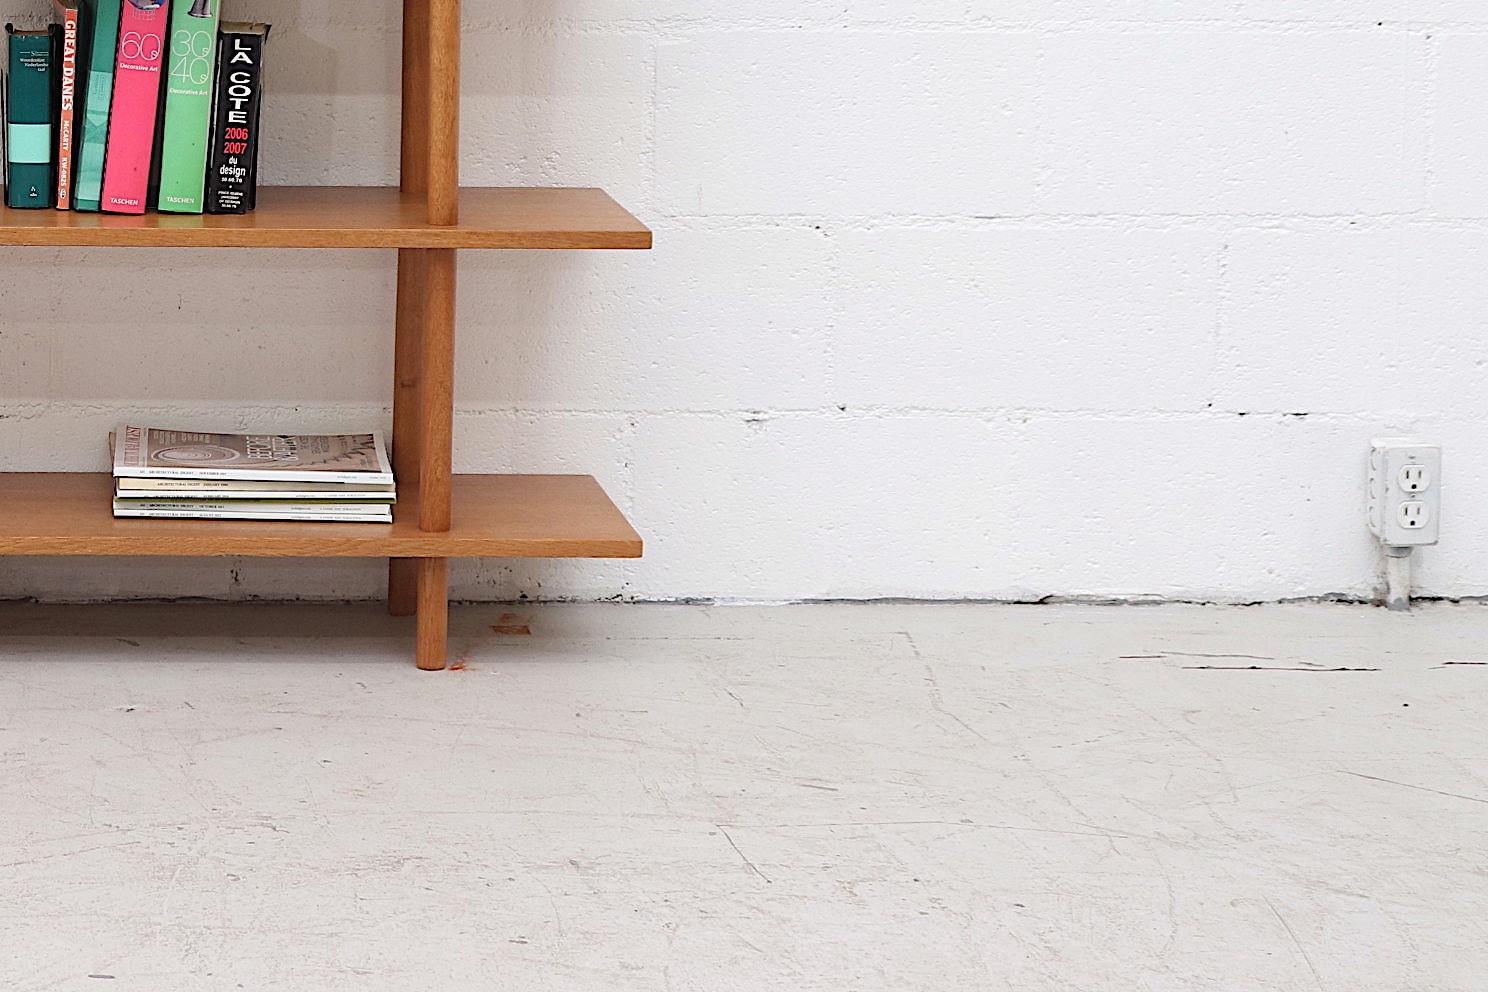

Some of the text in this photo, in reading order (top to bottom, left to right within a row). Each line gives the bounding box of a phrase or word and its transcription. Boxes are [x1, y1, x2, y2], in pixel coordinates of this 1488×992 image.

[121, 31, 161, 61] 60s
[172, 29, 212, 58] 30s
[230, 38, 253, 65] LA
[61, 20, 76, 111] GREAT DANES
[119, 62, 148, 71] Decorative
[171, 56, 210, 85] 40s
[169, 87, 198, 95] Decorative
[62, 119, 70, 152] McCARTY
[224, 127, 248, 140] 2006
[223, 141, 247, 154] 2007
[228, 155, 238, 165] du
[219, 164, 246, 178] design
[110, 197, 139, 206] TASCHEN
[166, 196, 195, 204] TASCHEN
